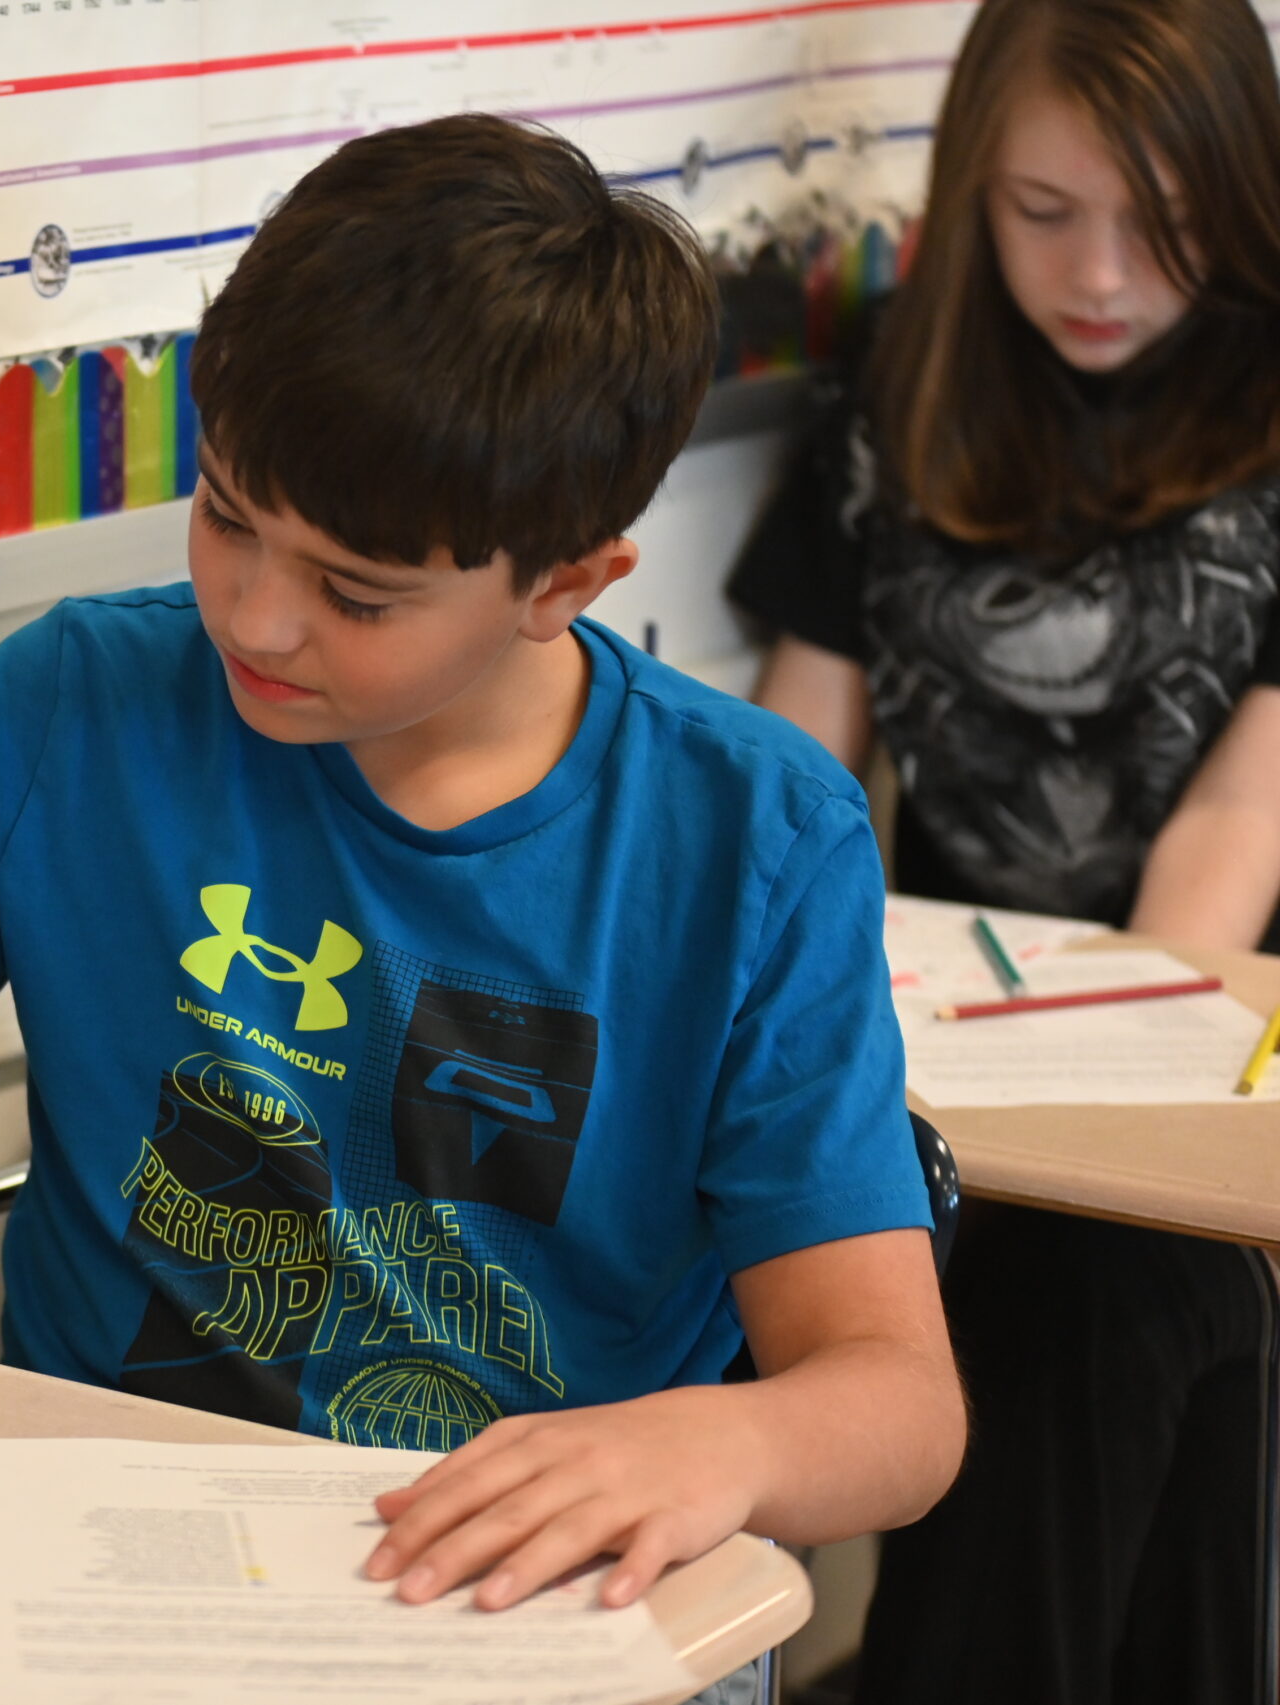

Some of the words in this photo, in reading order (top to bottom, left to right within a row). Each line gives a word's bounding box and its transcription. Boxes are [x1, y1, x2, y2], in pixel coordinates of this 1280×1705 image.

[176, 995, 244, 1036] UNDER
[245, 1027, 348, 1081] ARMOUR
[244, 1090, 287, 1125] 1996
[121, 1135, 462, 1267] PERFORMANCE
[192, 1260, 565, 1399] APPAREL
[342, 1359, 388, 1394] ARMOUR
[390, 1357, 433, 1365] UNDER
[434, 1362, 481, 1390] ARMOUR
